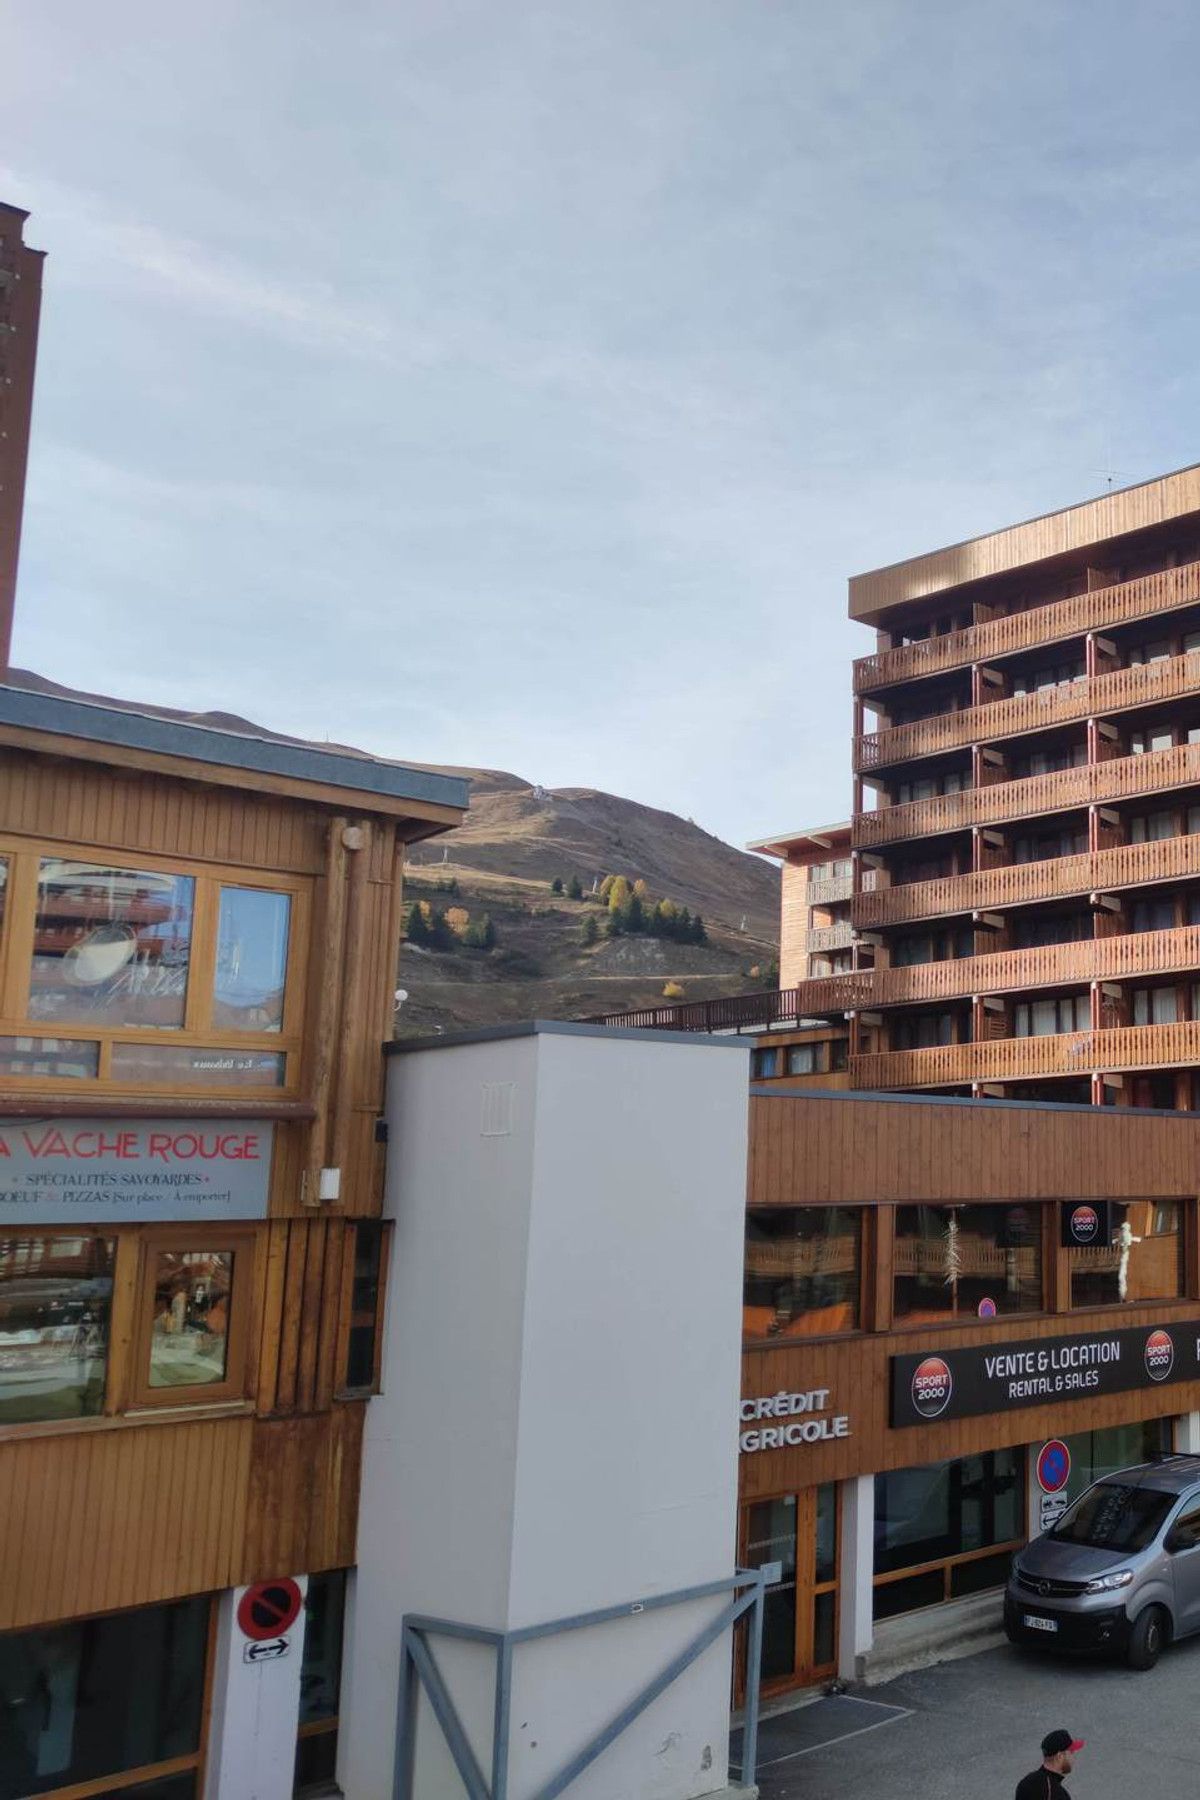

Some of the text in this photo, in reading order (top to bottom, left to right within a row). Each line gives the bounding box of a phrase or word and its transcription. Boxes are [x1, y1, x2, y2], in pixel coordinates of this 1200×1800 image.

[22, 1128, 140, 1159] VACHE
[149, 1132, 261, 1162] ROUGE
[62, 1190, 110, 1202] PIZZAS
[1073, 1216, 1095, 1224] SPORT
[1147, 1344, 1171, 1356] SPORT
[985, 1341, 1120, 1379] VENTE & LOCATION
[1149, 1355, 1168, 1366] 2000
[915, 1374, 948, 1389] SPORT
[1009, 1370, 1099, 1399] RENTAL & SALES
[918, 1389, 945, 1400] 2000
[740, 1390, 829, 1421] CRÉDIT
[739, 1416, 852, 1453] GRICOLE
